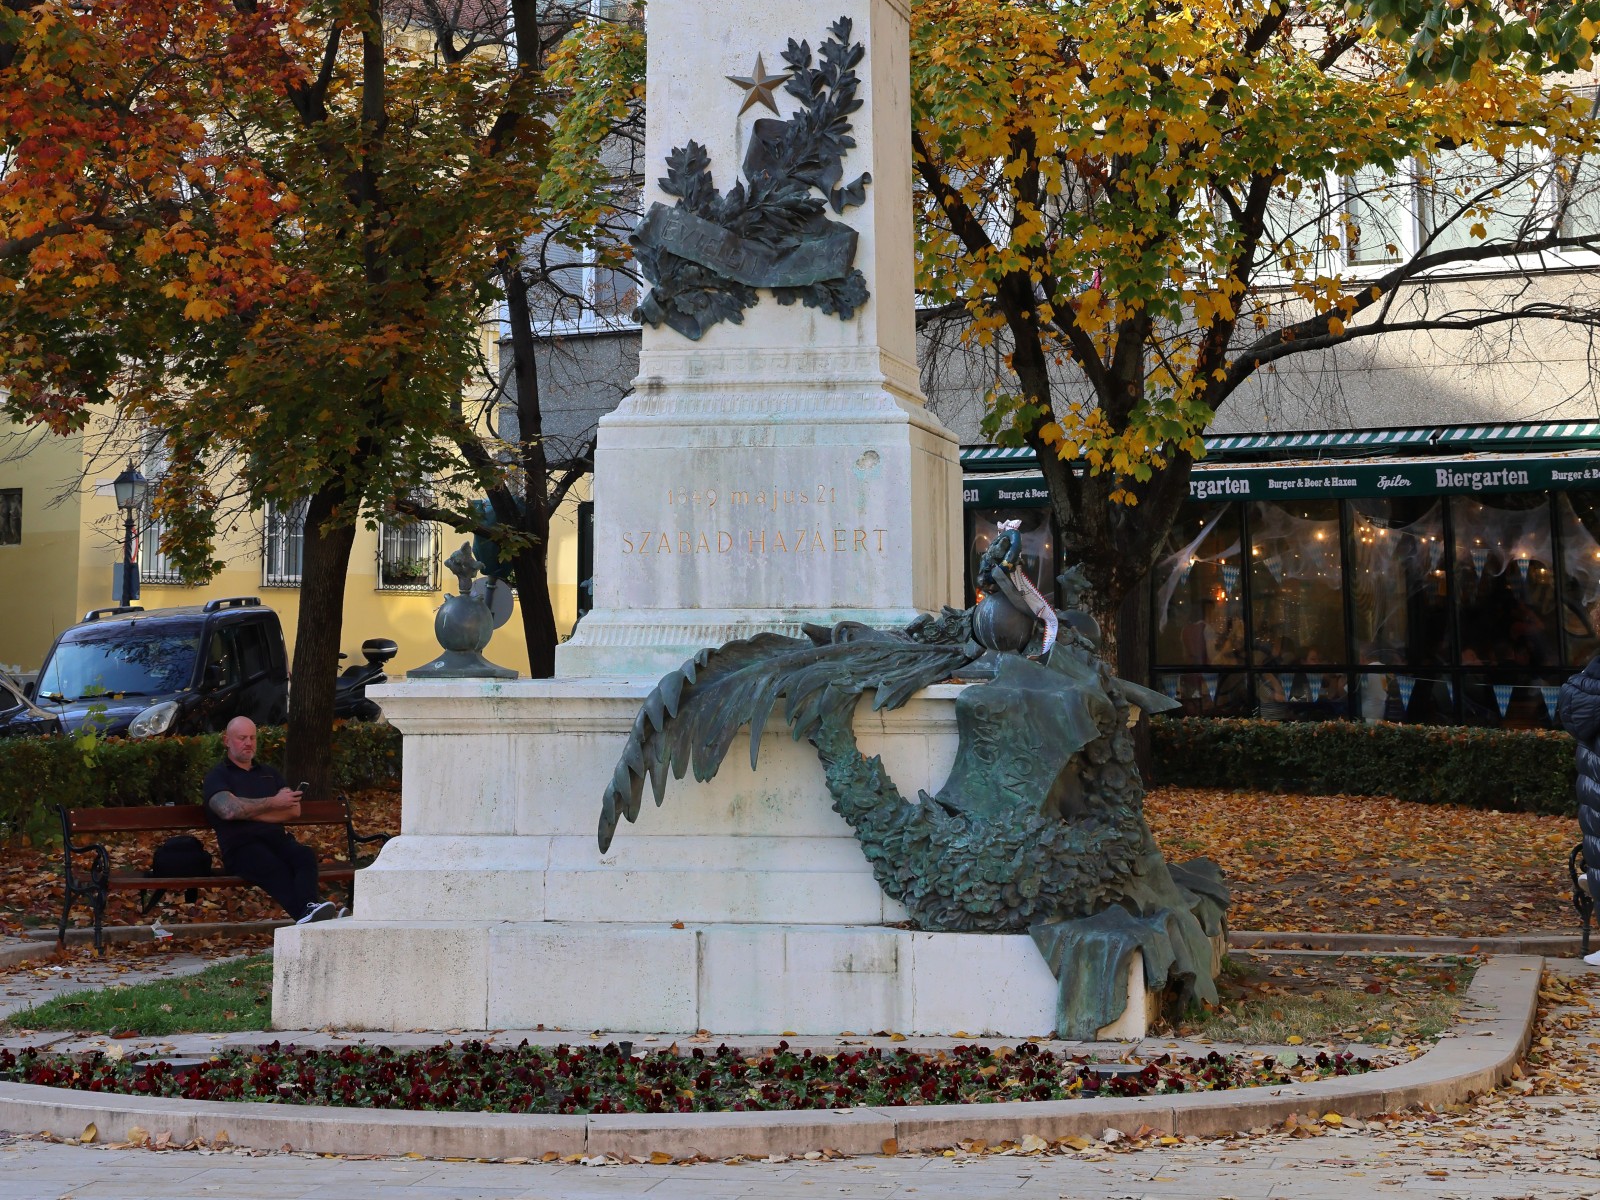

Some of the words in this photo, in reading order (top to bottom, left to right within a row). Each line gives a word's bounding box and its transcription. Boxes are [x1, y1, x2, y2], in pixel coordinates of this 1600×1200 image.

[1268, 478, 1296, 490] Burger
[1296, 478, 1304, 488] &
[1304, 477, 1323, 488] Beer
[1323, 477, 1331, 487] &
[1331, 476, 1358, 487] Haxen
[1377, 474, 1412, 490] Spiler
[1435, 467, 1529, 491] Biergarten
[1552, 470, 1583, 481] Burger
[1583, 469, 1591, 479] &
[667, 485, 718, 508] 1849
[816, 484, 836, 503] 21
[998, 489, 1024, 501] Burger
[1024, 489, 1031, 499] &
[1031, 488, 1049, 498] Beer
[1189, 476, 1251, 500] rgarten
[621, 530, 733, 554] SZABAD
